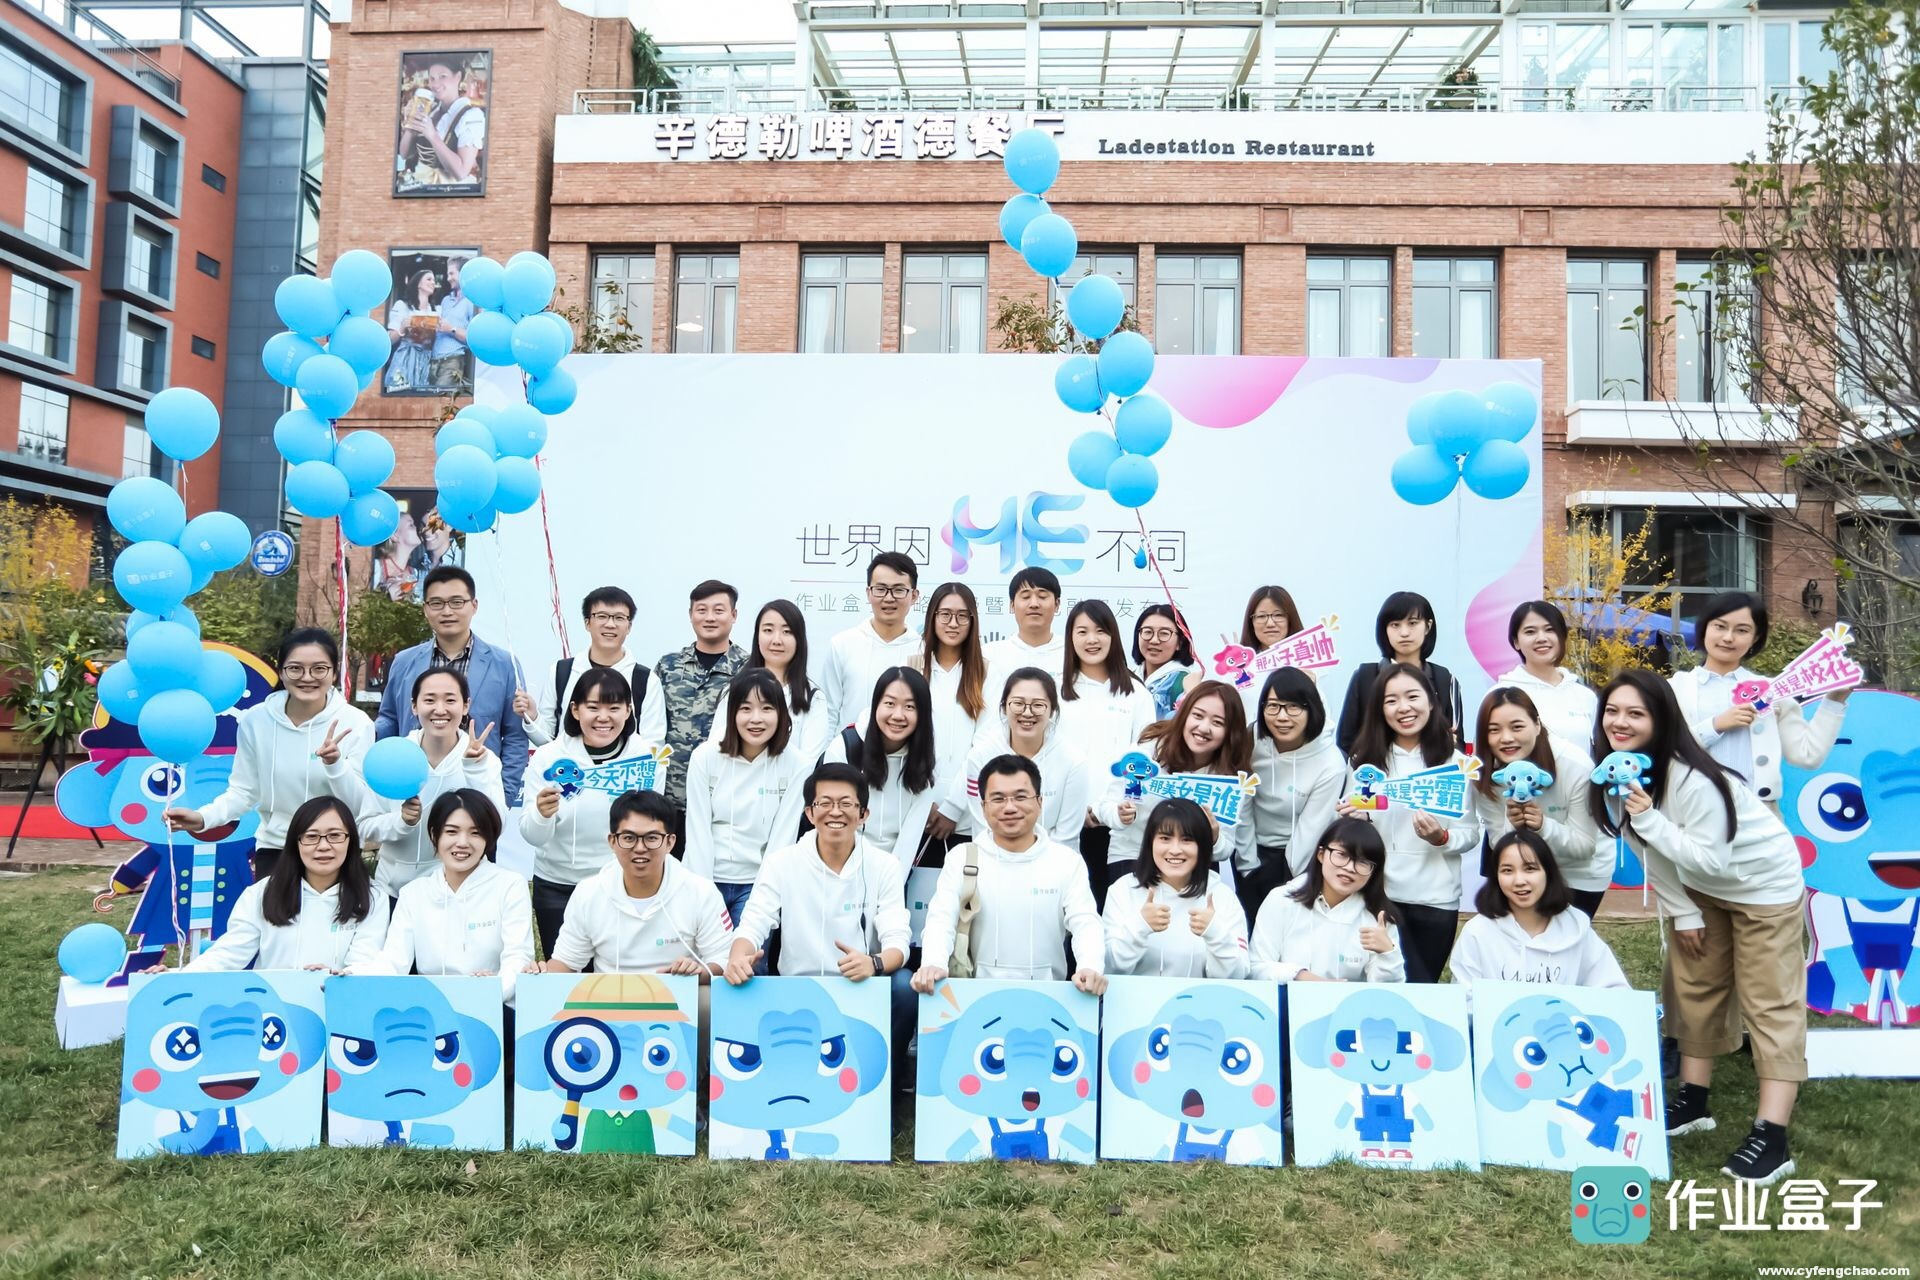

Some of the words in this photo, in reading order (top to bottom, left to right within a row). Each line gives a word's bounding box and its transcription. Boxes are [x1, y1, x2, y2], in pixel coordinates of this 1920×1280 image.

[1099, 138, 1235, 155] Ladestation
[1246, 140, 1375, 157] Restaurant
[1256, 631, 1335, 671] 那小子真帅
[1774, 644, 1861, 697] 我是校花
[1150, 781, 1241, 819] 那美女是谁
[1383, 773, 1466, 811] 我是学霸
